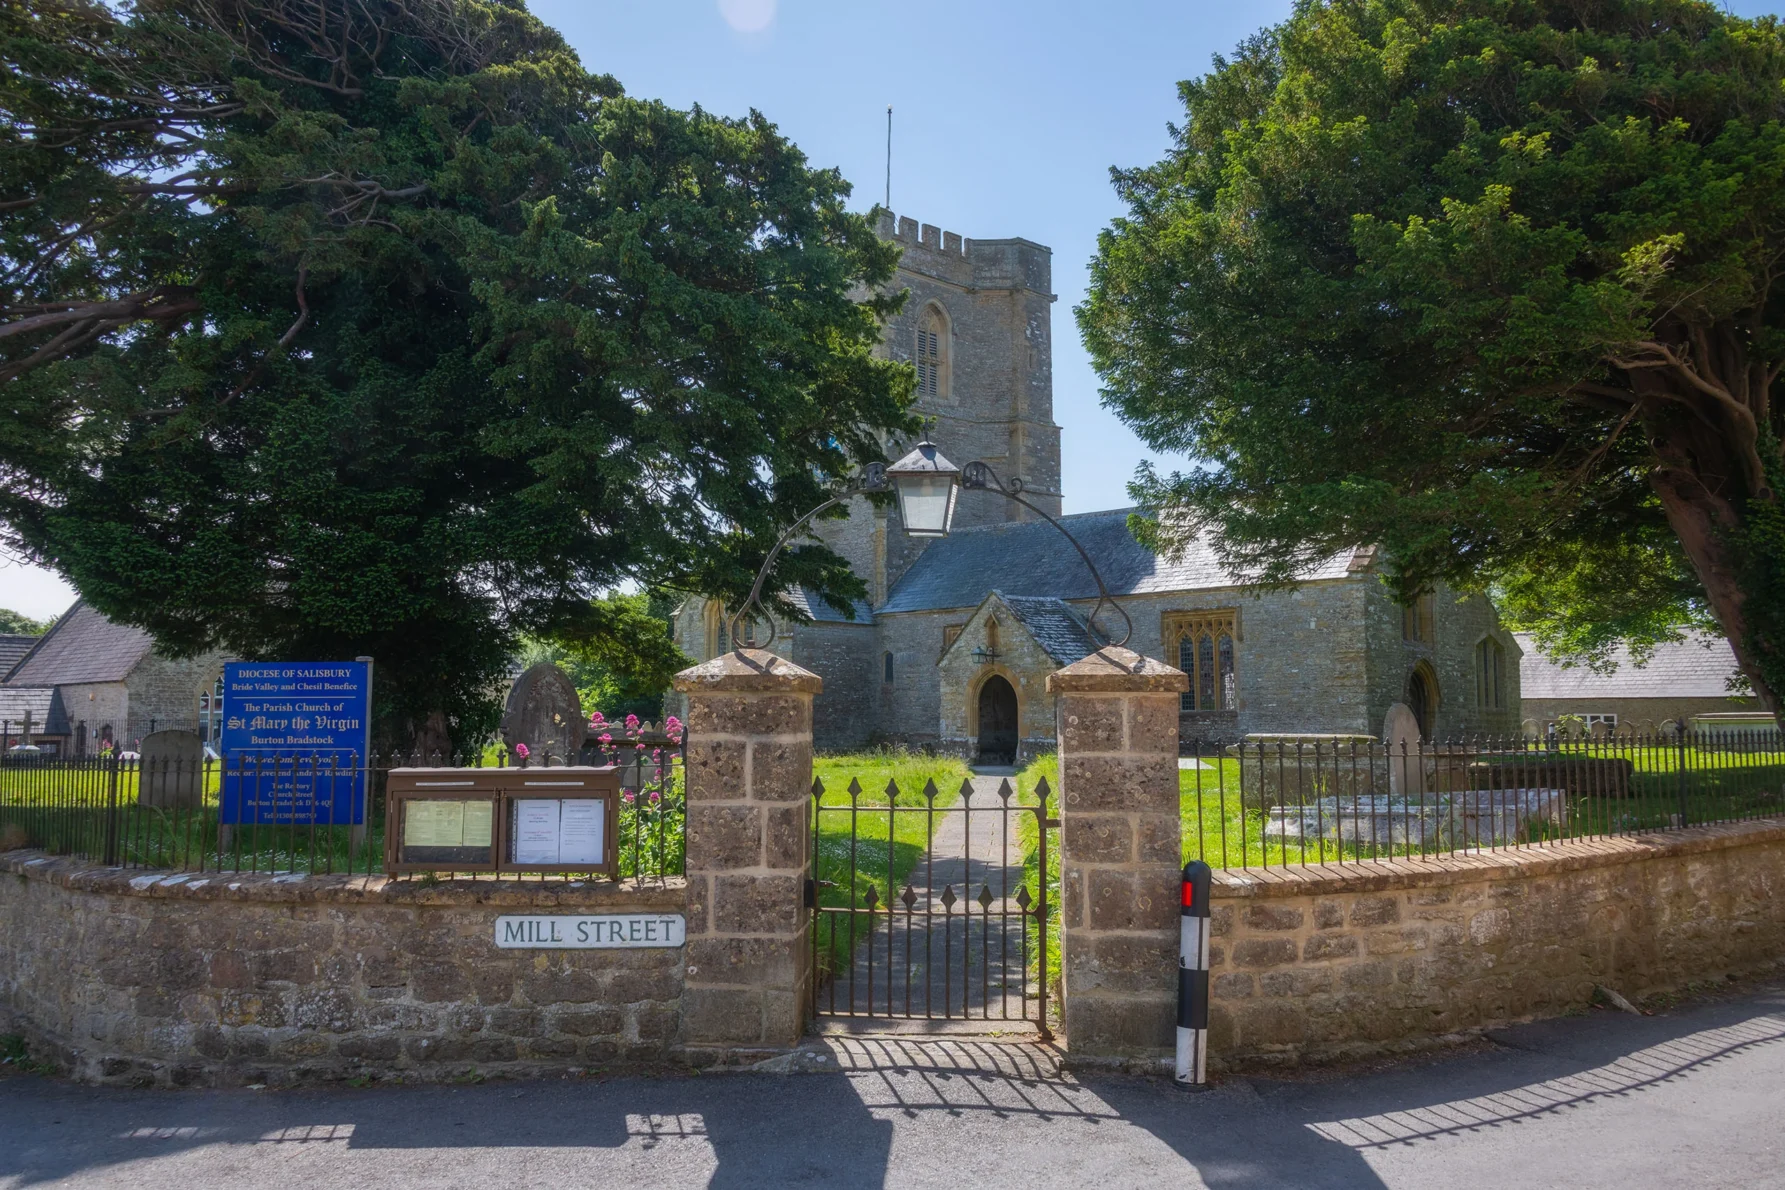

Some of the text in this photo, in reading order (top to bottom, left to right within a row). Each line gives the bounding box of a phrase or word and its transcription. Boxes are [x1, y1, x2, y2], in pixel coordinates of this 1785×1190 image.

[238, 669, 351, 678] DIOCESE OF SALISBURY
[232, 682, 357, 693] Bride Valley and Chesil Benefice
[244, 703, 344, 712] The Parish Church of
[227, 715, 359, 731] St Mary the Virgin
[251, 735, 334, 744] Burton Bradstock
[504, 919, 676, 942] MILL STREET
